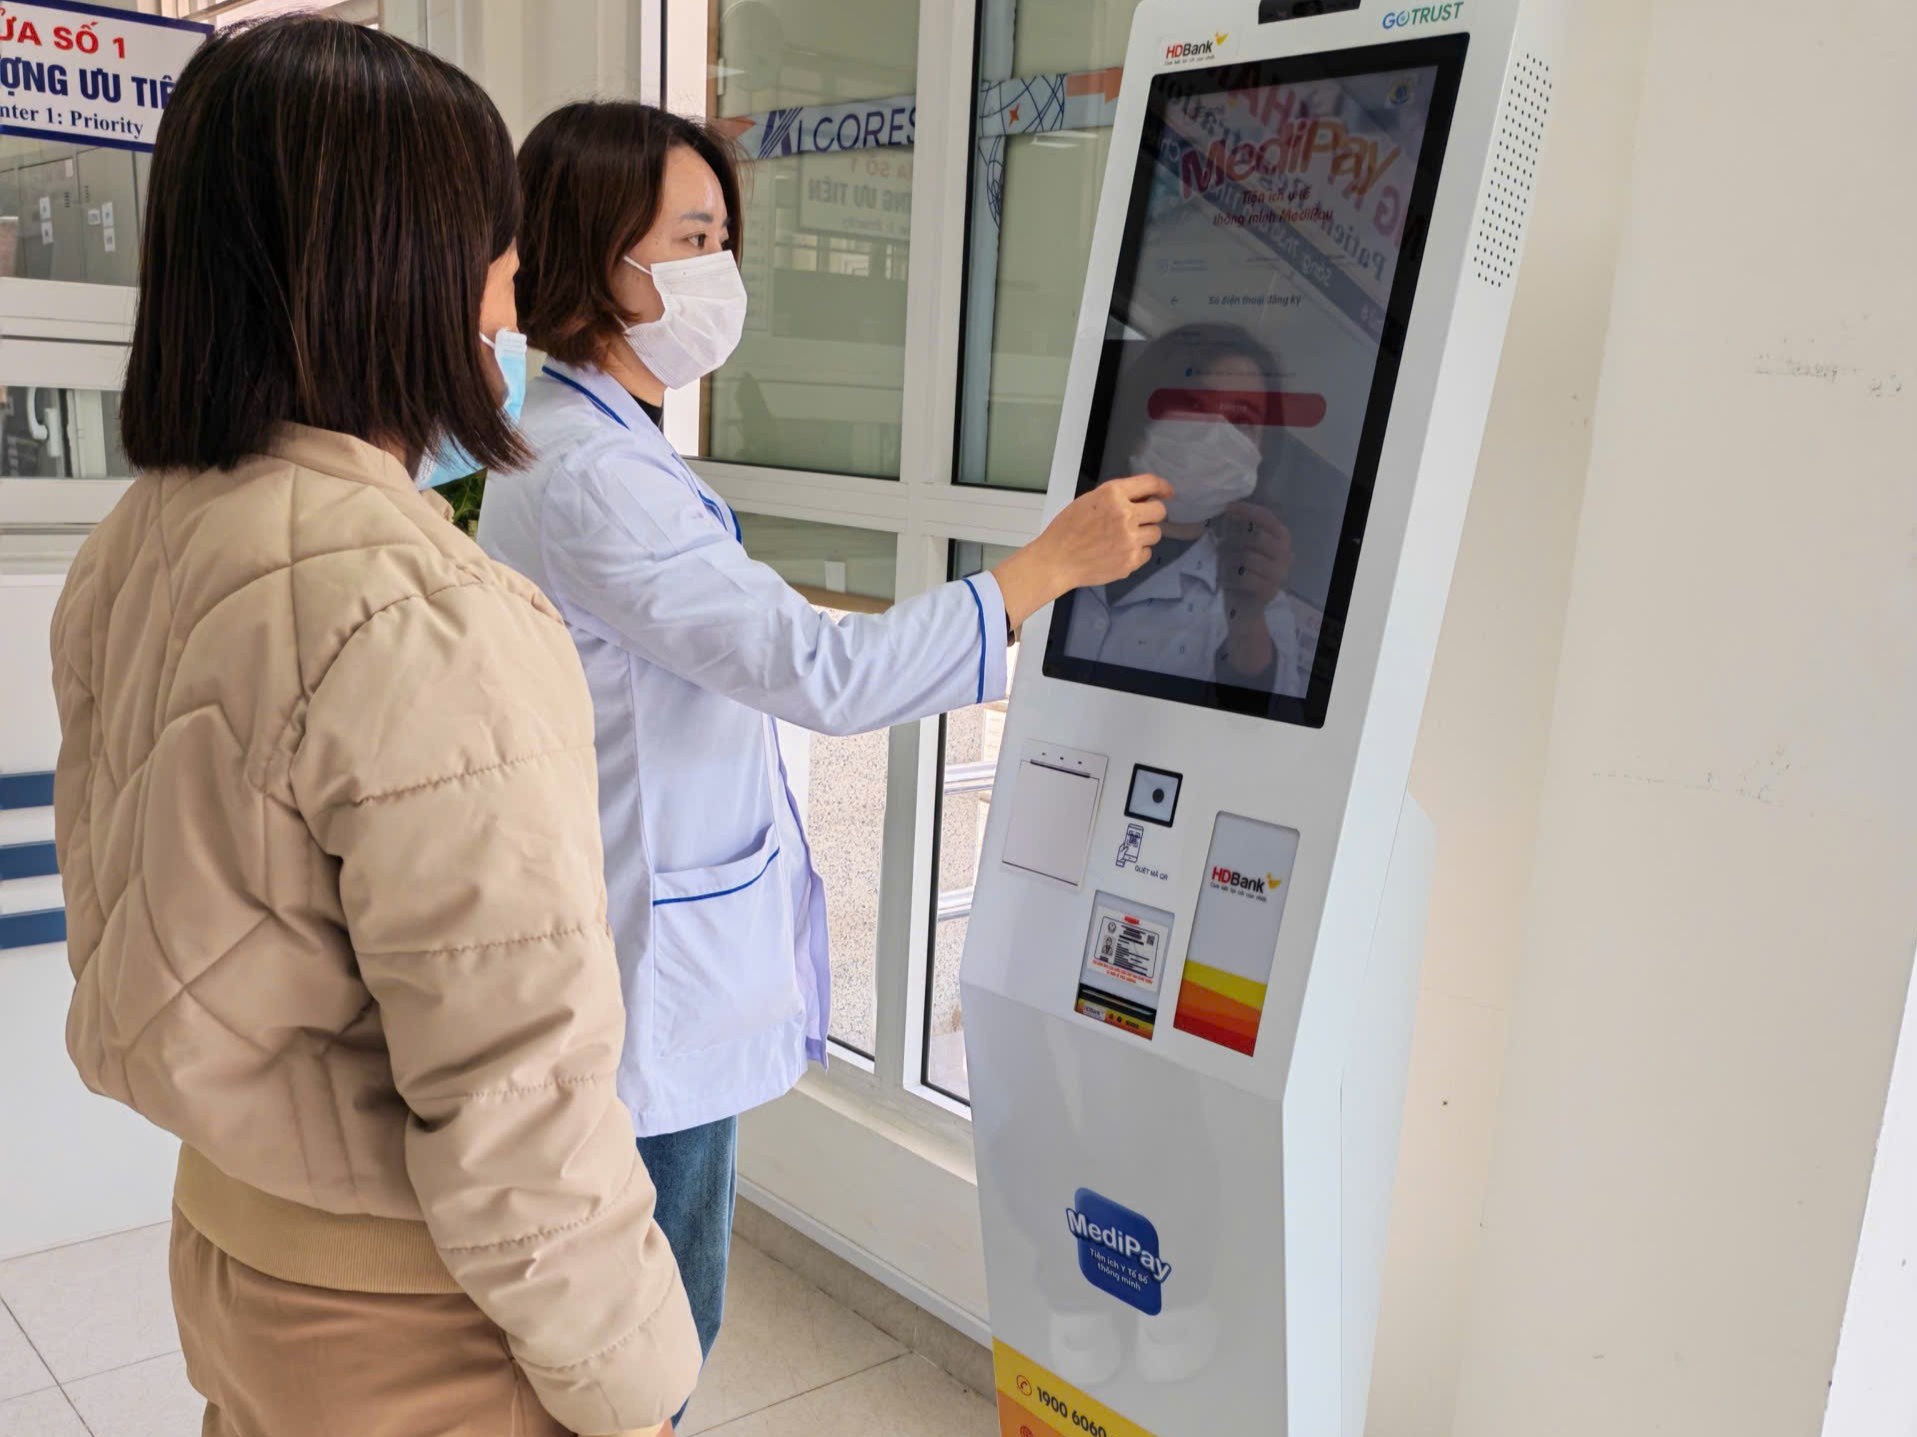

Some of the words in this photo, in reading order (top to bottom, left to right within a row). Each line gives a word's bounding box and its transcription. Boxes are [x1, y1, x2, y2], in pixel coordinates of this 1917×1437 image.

[1382, 1, 1465, 30] GOTRUST
[53, 21, 99, 55] SỐ
[112, 37, 126, 59] 1
[1165, 40, 1214, 59] HDBank
[0, 56, 68, 98] ỢNG
[79, 67, 122, 104] ƯU
[131, 75, 177, 110] TIÊ
[46, 107, 63, 125] 1:
[70, 110, 144, 139] Priority
[1181, 117, 1400, 198] MediPay
[1212, 866, 1265, 894] HDBank
[1067, 1208, 1171, 1281] MediPay
[1097, 1262, 1120, 1281] thông
[1121, 1276, 1141, 1291] minh
[1037, 1386, 1068, 1418] 1900
[1071, 1410, 1107, 1437] 6060
